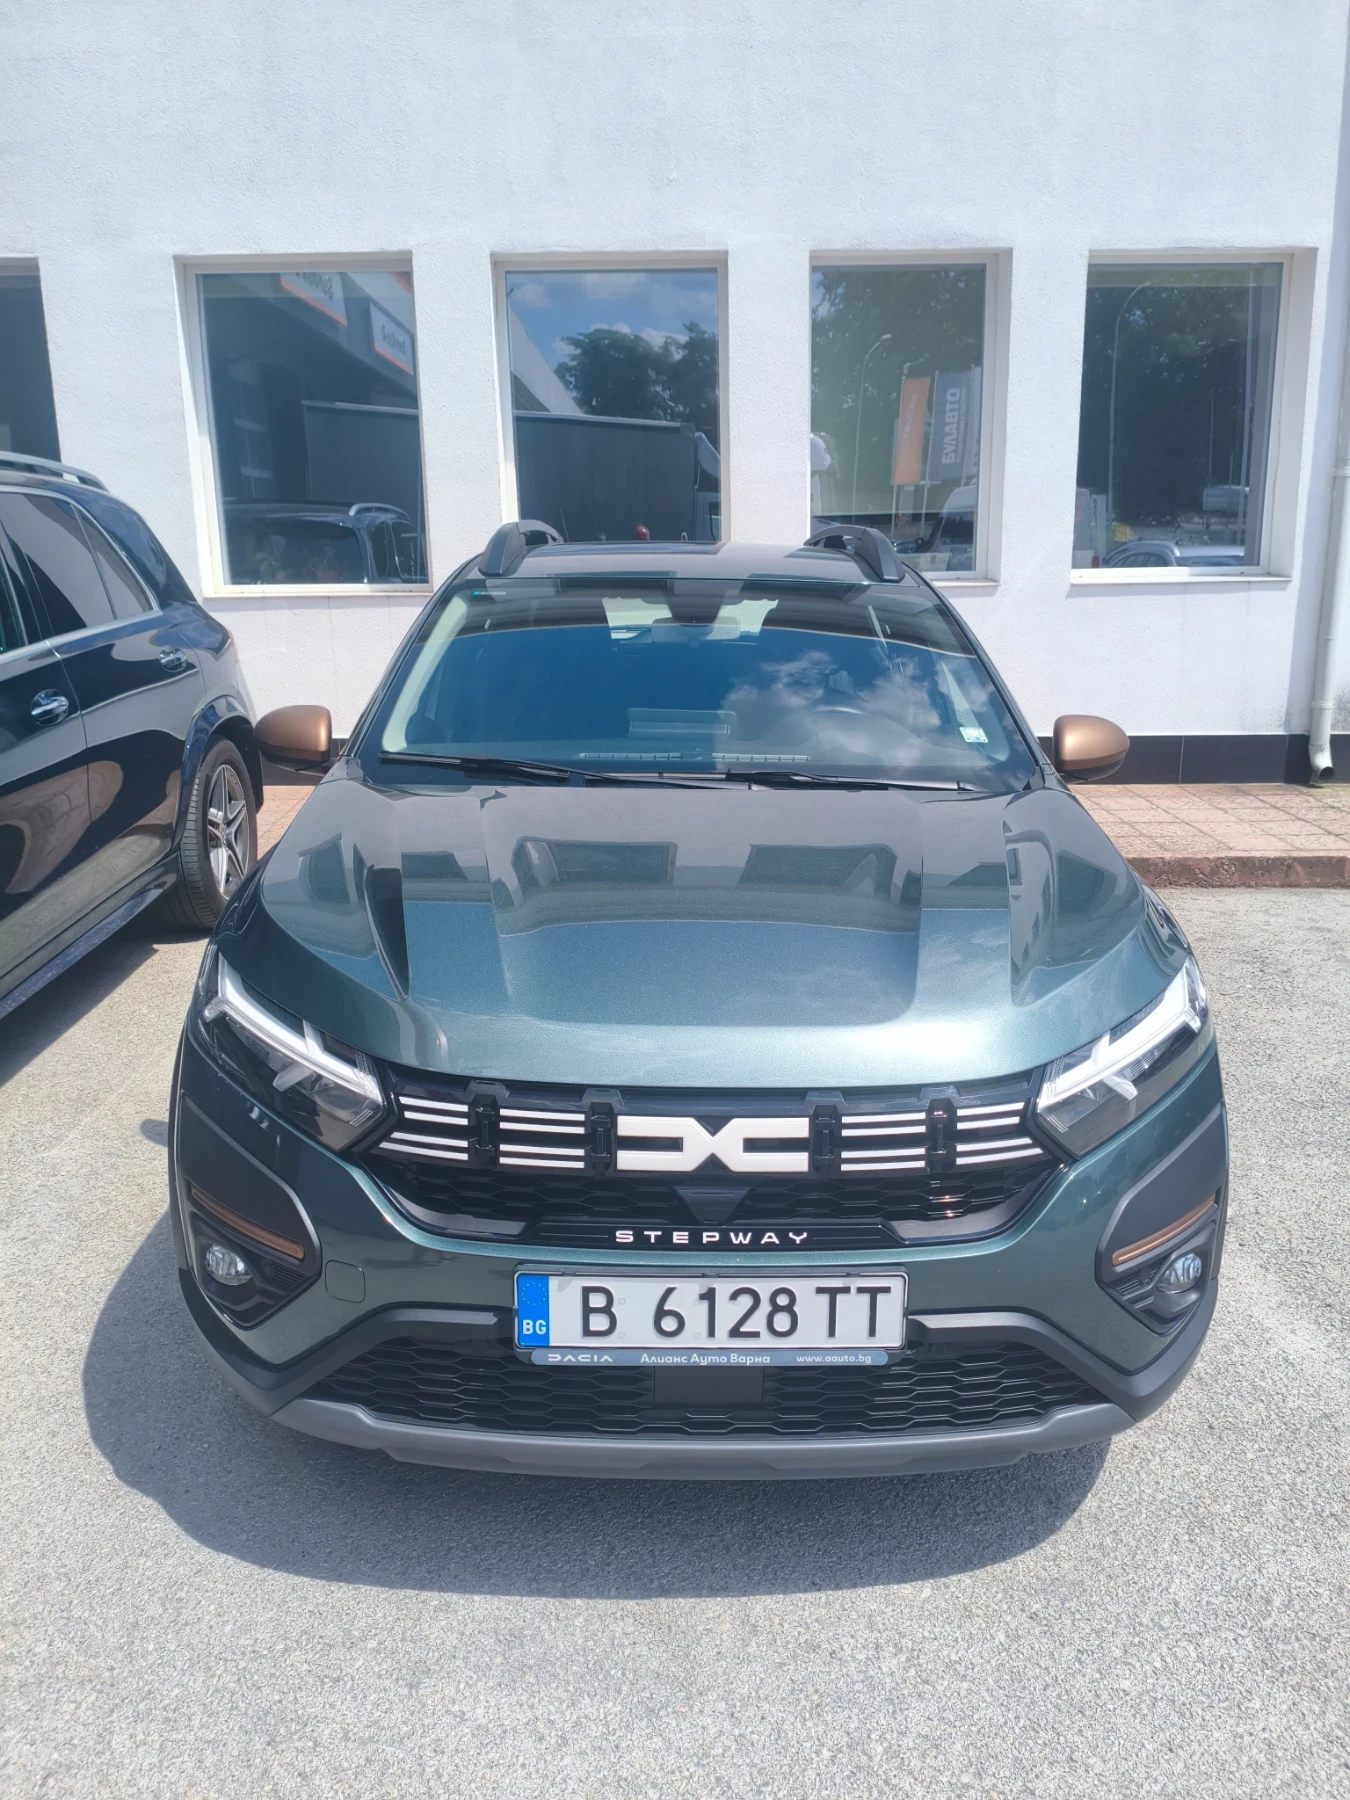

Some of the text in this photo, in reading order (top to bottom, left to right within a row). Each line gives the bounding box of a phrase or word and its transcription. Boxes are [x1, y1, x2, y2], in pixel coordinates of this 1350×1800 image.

[941, 387, 961, 464] БУЛАВТО
[615, 1229, 809, 1245] STEPWAY
[581, 1285, 892, 1339] B 6128 TT
[521, 1318, 548, 1336] BG
[547, 1353, 614, 1363] DACIA
[730, 1352, 771, 1367] Варна
[796, 1354, 872, 1365] www.aauto.bg
